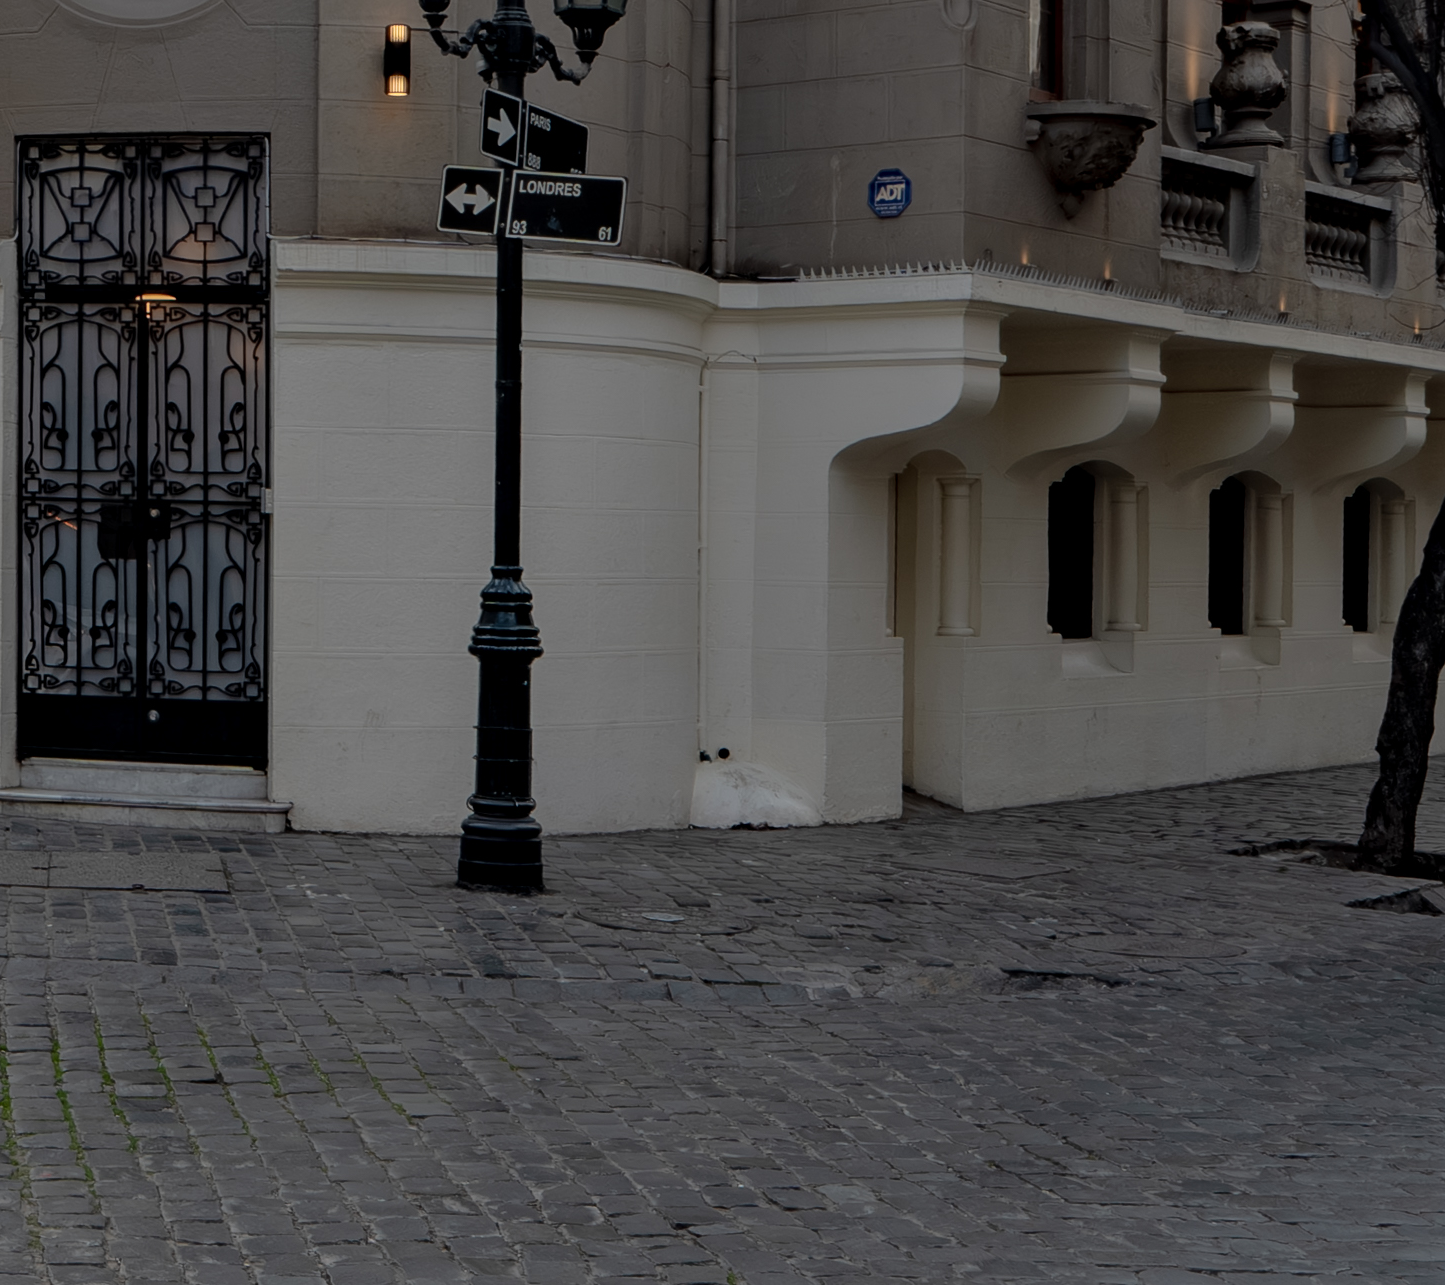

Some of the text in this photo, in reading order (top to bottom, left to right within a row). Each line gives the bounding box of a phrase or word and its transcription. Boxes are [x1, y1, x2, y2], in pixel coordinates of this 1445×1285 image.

[530, 112, 551, 131] PARIS
[518, 180, 582, 197] LONDRES
[875, 183, 906, 201] ADT
[511, 220, 612, 241] 93 61
